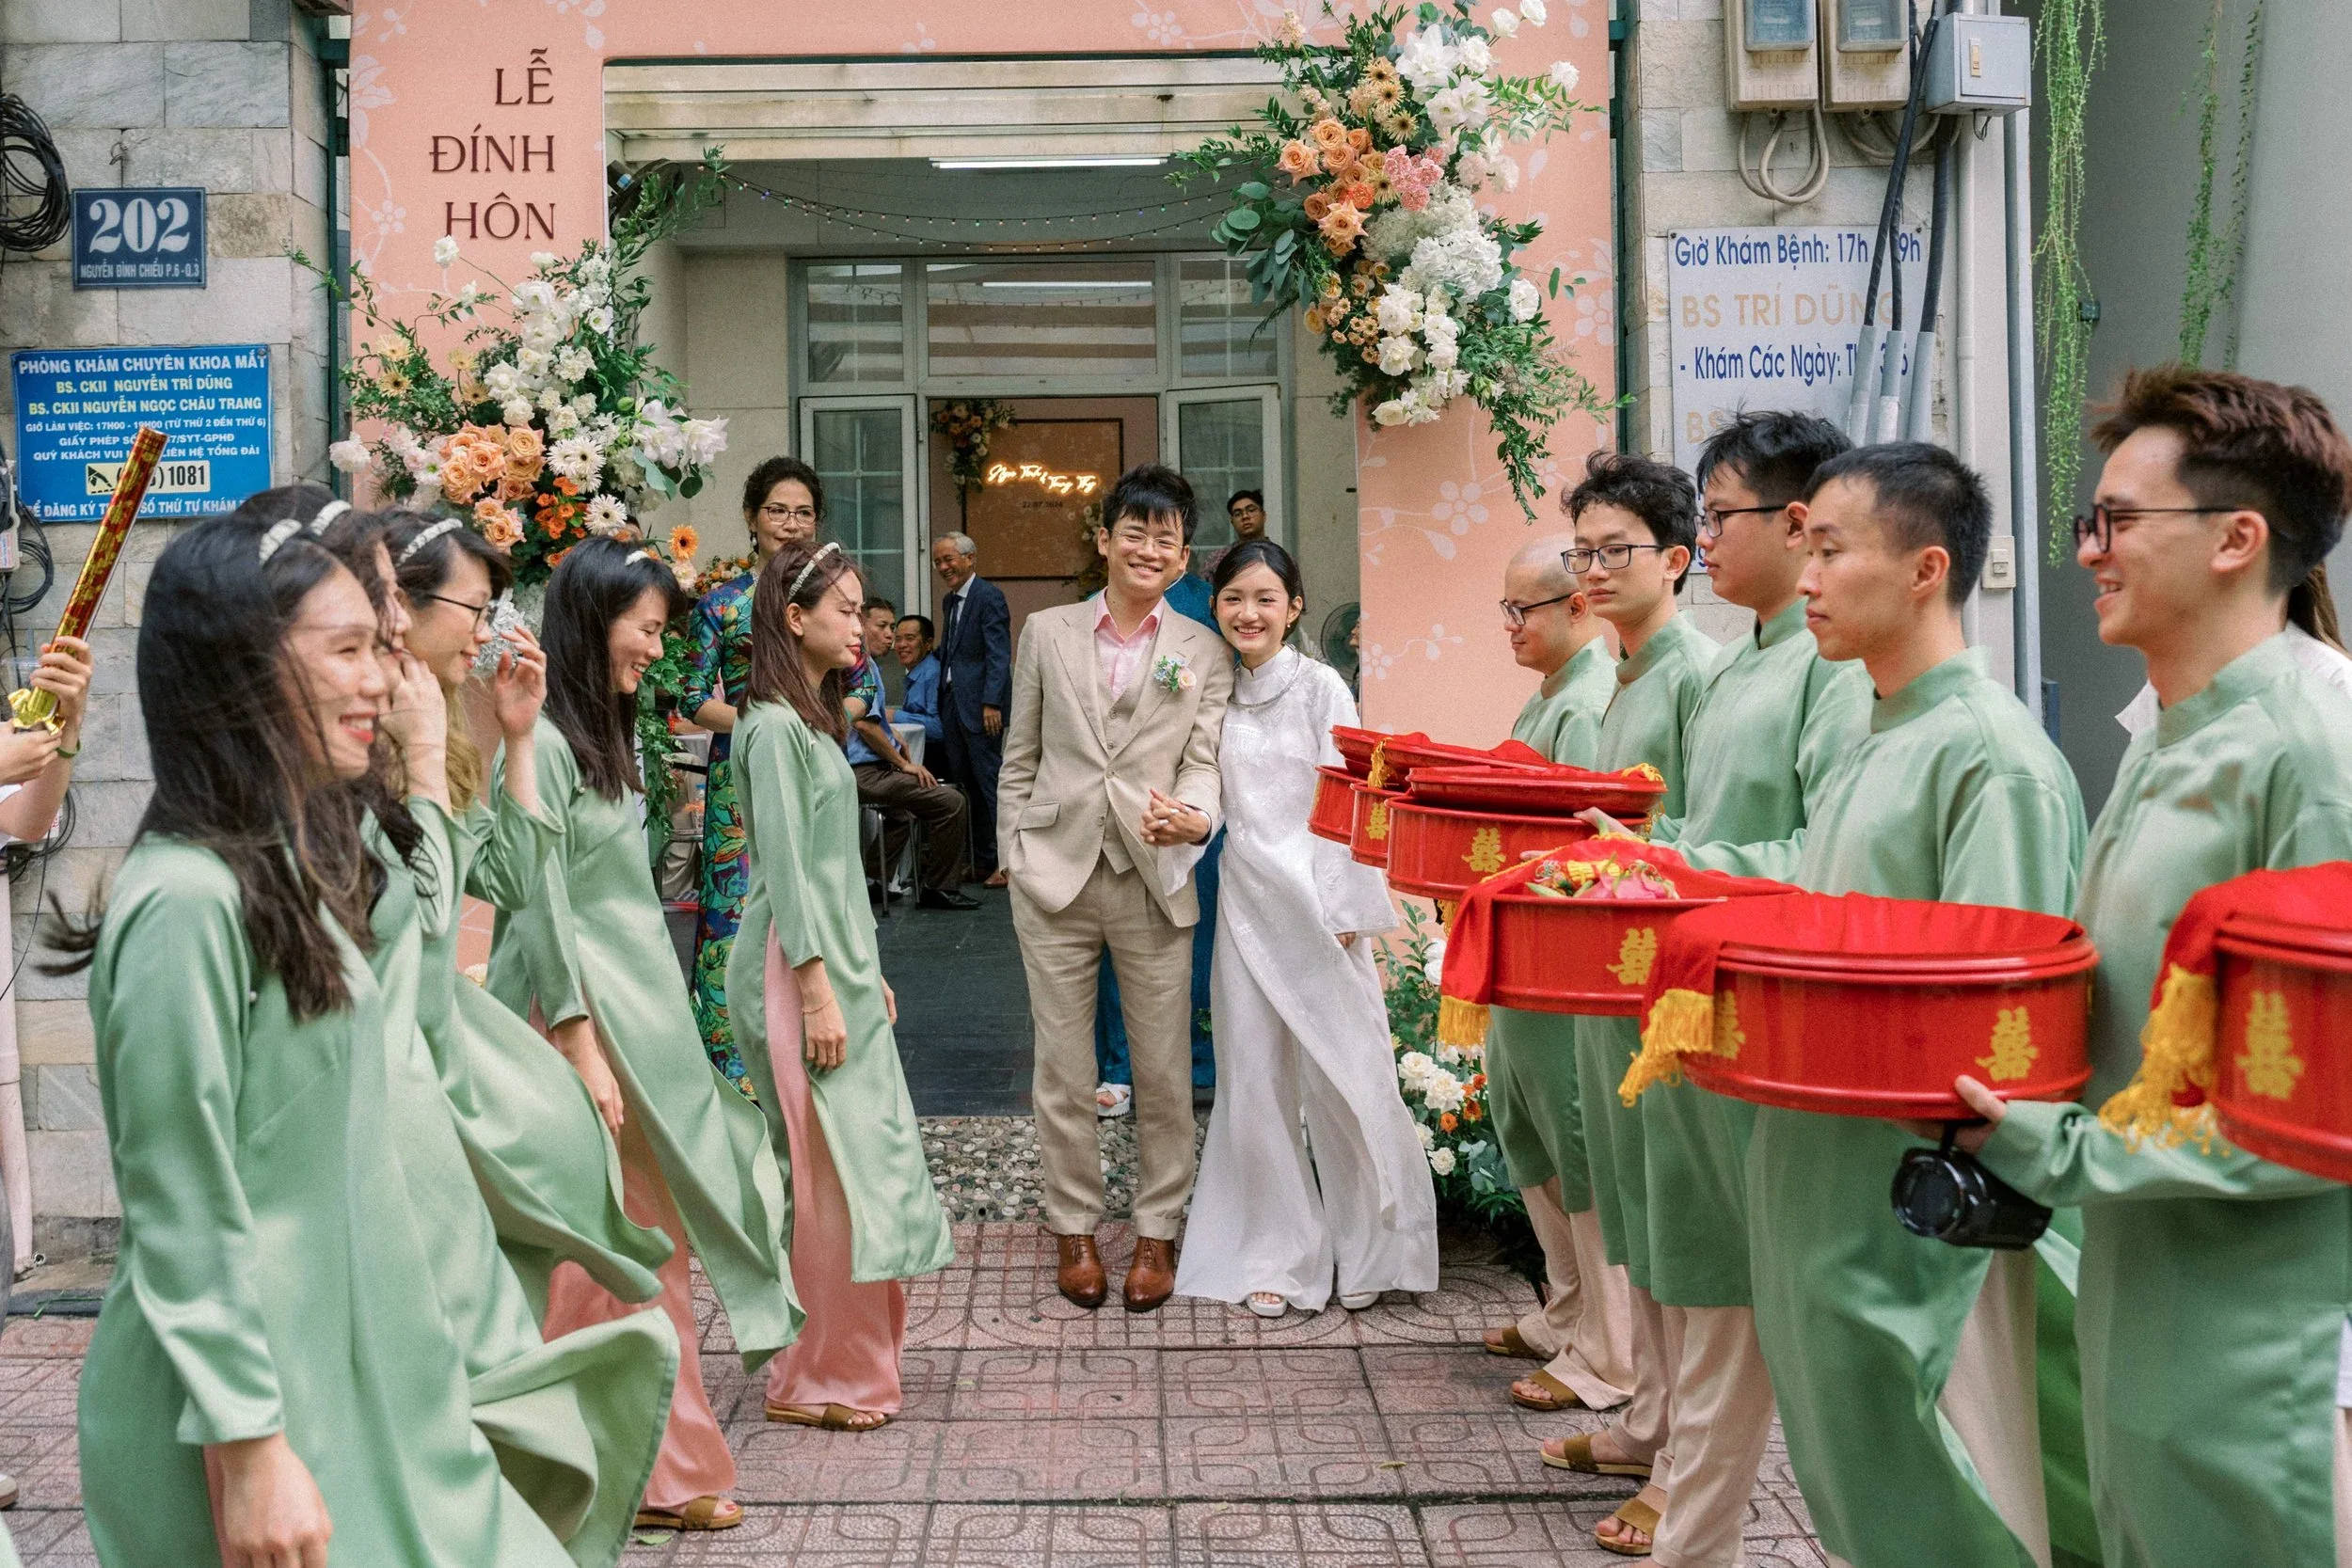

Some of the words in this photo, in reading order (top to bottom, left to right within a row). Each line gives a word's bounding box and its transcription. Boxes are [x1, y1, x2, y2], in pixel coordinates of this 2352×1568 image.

[495, 48, 554, 105] LỄ
[429, 123, 555, 172] ĐÍNH
[89, 198, 190, 253] 202
[445, 192, 555, 240] HÔN
[1716, 234, 1771, 265] Khám
[1777, 234, 1830, 270] Bệnh:
[1836, 233, 1868, 262] 17h
[80, 258, 114, 278] NGUYỄN
[116, 261, 136, 277] ĐÌNH
[138, 257, 164, 277] CHIỂU
[1681, 293, 1723, 328] BS
[1734, 283, 1782, 326] TRÍ
[19, 356, 71, 374] PHÒNG
[74, 355, 119, 372] KHÁM
[122, 354, 184, 372] CHUYÊN
[189, 356, 231, 370] KHOA
[235, 349, 266, 369] MẮT
[1695, 347, 1743, 379] Khám
[1750, 343, 1785, 378] Các
[1790, 342, 1841, 387] Ngày:
[56, 381, 77, 393] BS.
[80, 380, 106, 392] CKII
[114, 373, 168, 392] NGUYỄN
[171, 374, 193, 390] TRÍ
[197, 374, 233, 390] DŨNG
[28, 403, 50, 415] BS.
[53, 402, 79, 414] CKII
[83, 395, 136, 413] NGUYỄN
[139, 399, 176, 415] NGỌC
[180, 396, 215, 411] CHÂU
[218, 397, 262, 410] TRANG
[45, 420, 66, 432] LÀM
[69, 420, 94, 433] VIỆC:
[96, 421, 125, 430] 17H00
[183, 417, 203, 427] THỨ
[206, 419, 212, 427] 2
[214, 415, 233, 427] ĐẾN
[235, 416, 255, 426] THỨ
[257, 418, 266, 427] 6)
[58, 434, 87, 446] GIẤY
[89, 435, 119, 445] PHÉP
[33, 450, 58, 461] QUÝ
[60, 449, 101, 460] KHÁCH
[189, 447, 204, 458] HỆ
[207, 444, 238, 456] TỔNG
[240, 444, 260, 455] ĐÀI
[167, 465, 205, 486] 1081
[43, 501, 77, 516] ĐĂNG
[80, 500, 96, 515] KÝ
[140, 497, 155, 514] SỐ
[158, 498, 183, 514] THỨ
[184, 498, 201, 515] TỰ
[203, 497, 236, 512] KHÁM
